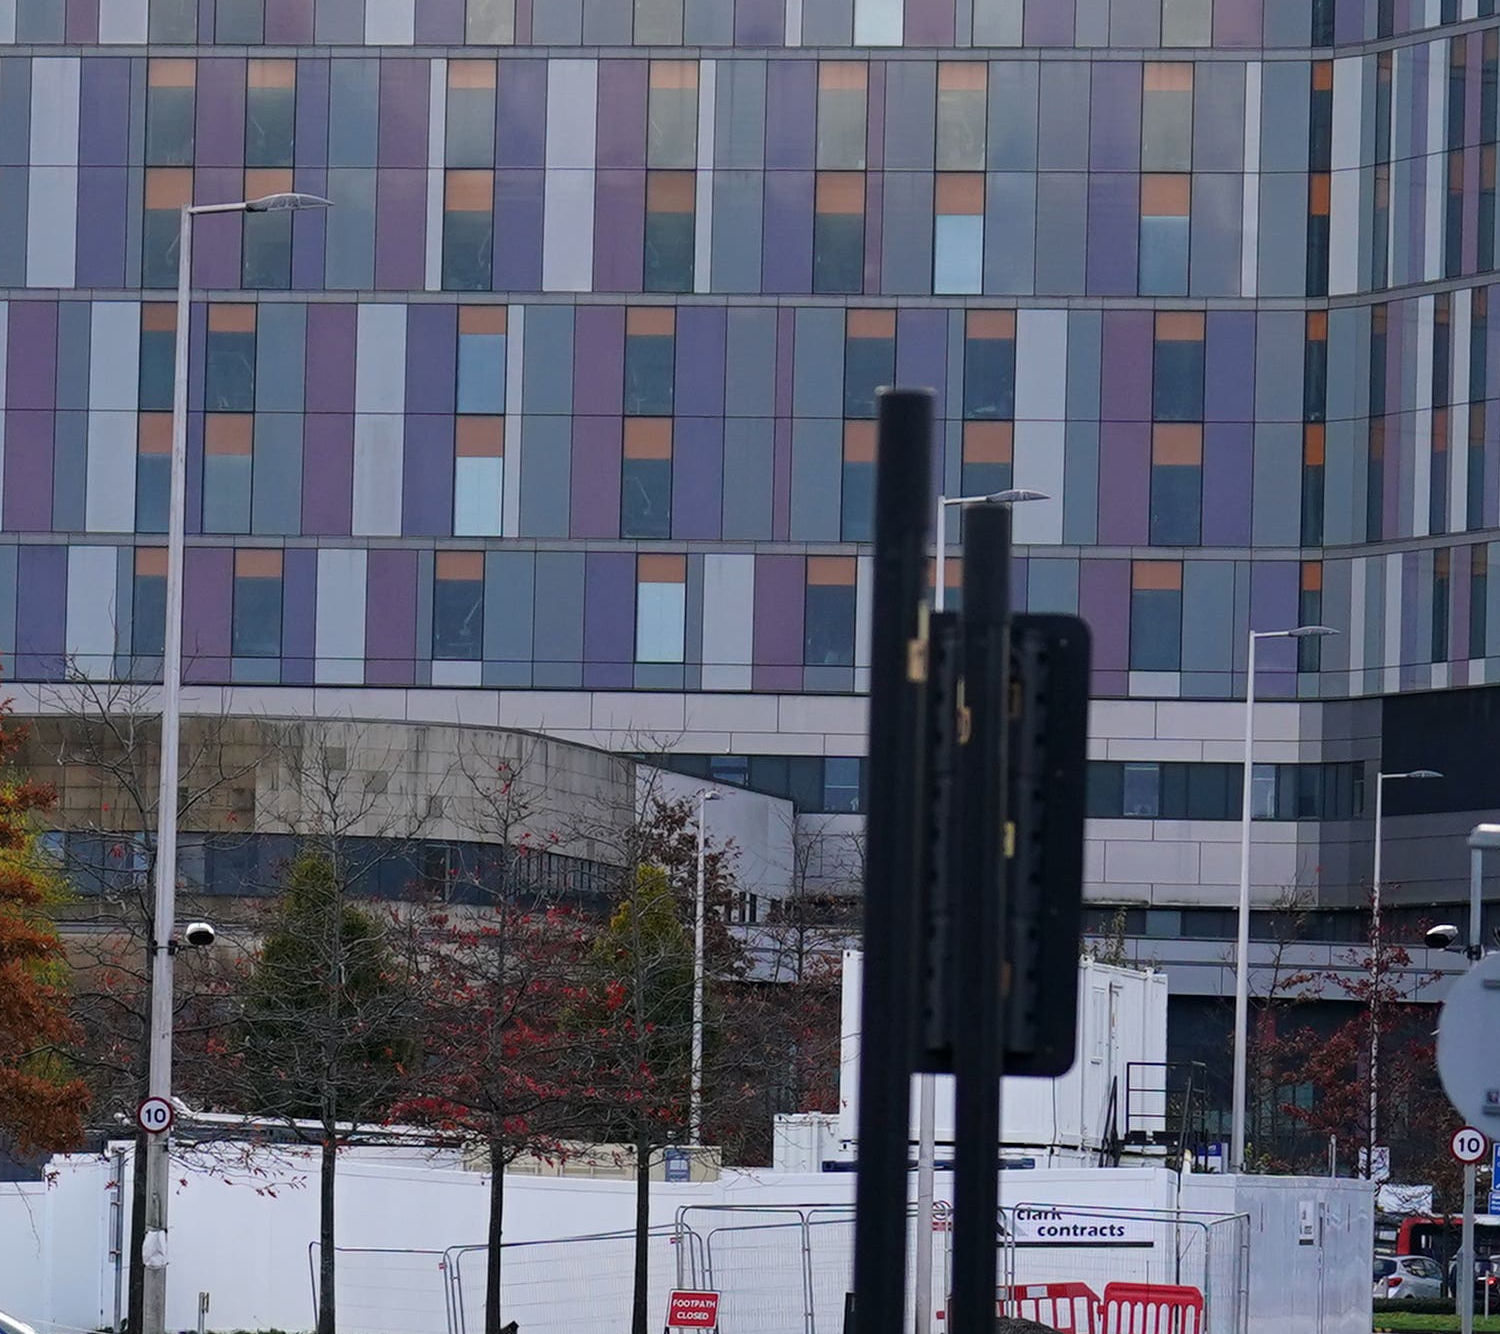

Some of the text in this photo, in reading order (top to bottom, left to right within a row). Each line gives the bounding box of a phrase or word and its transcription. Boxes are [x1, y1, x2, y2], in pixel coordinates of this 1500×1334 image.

[145, 1108, 166, 1124] 10
[1458, 1137, 1480, 1153] 10
[1017, 1207, 1062, 1221] clark
[1037, 1224, 1125, 1237] contracts
[672, 1299, 716, 1308] FOOTPATH
[676, 1311, 709, 1320] CLOSED
